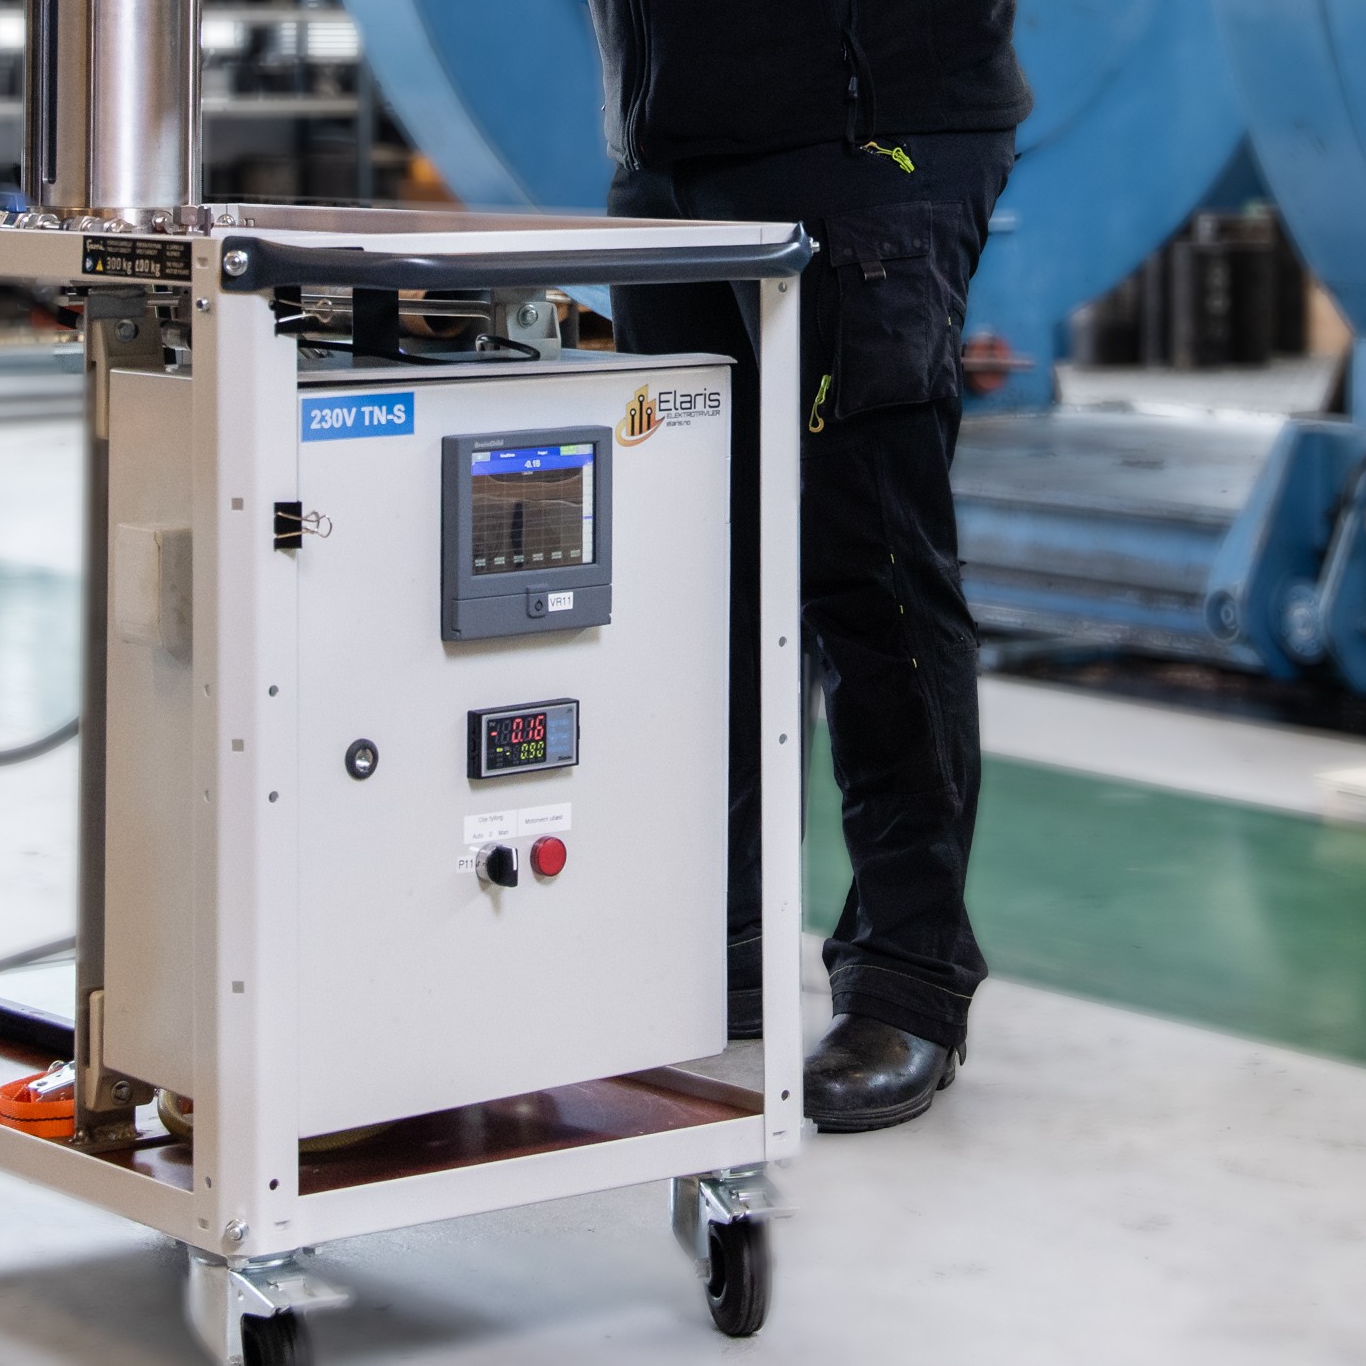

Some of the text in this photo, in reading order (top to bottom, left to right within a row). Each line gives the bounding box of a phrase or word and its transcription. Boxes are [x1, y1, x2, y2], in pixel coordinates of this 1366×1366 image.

[658, 387, 721, 412] Elaris
[310, 404, 406, 430] 230V TN-S
[550, 597, 572, 607] VR11
